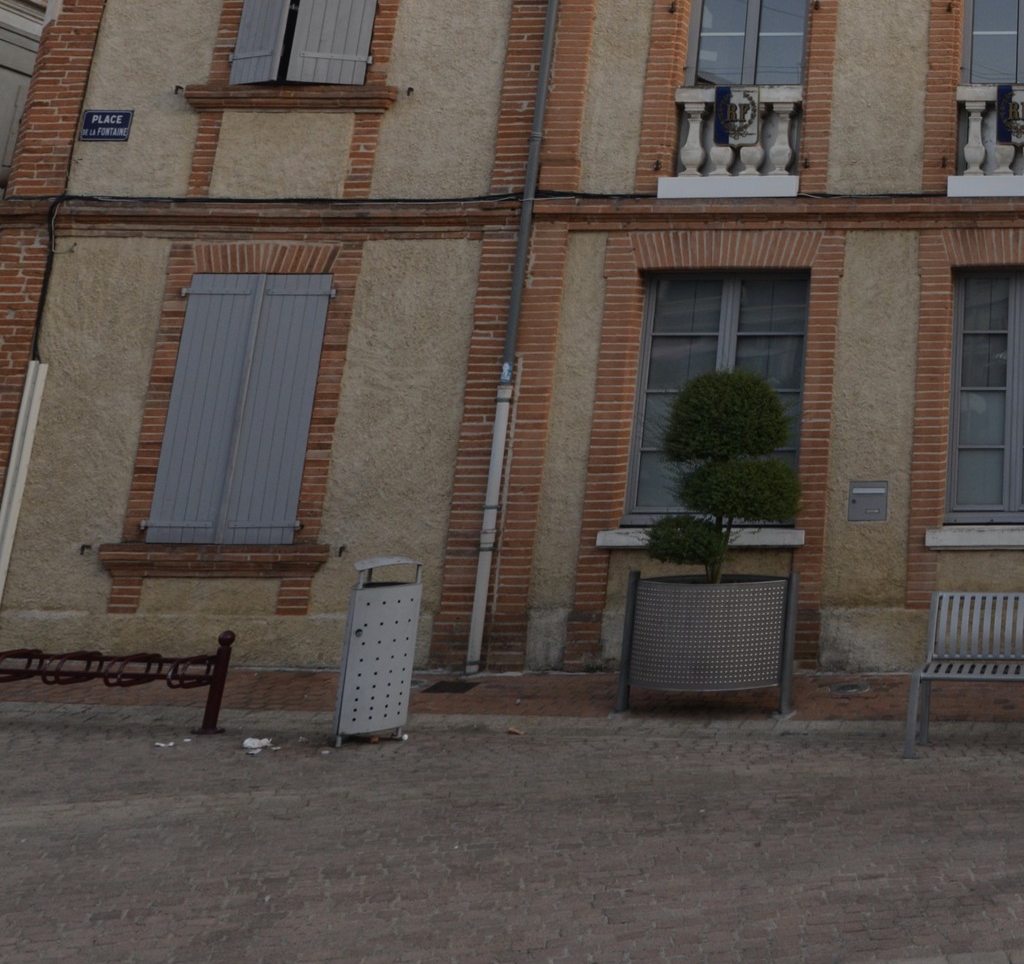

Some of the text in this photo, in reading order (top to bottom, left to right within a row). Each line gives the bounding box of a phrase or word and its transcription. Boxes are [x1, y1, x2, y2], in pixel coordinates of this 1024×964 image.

[727, 103, 750, 122] RF
[91, 115, 123, 123] PLACE
[97, 127, 128, 136] FONTAINE
